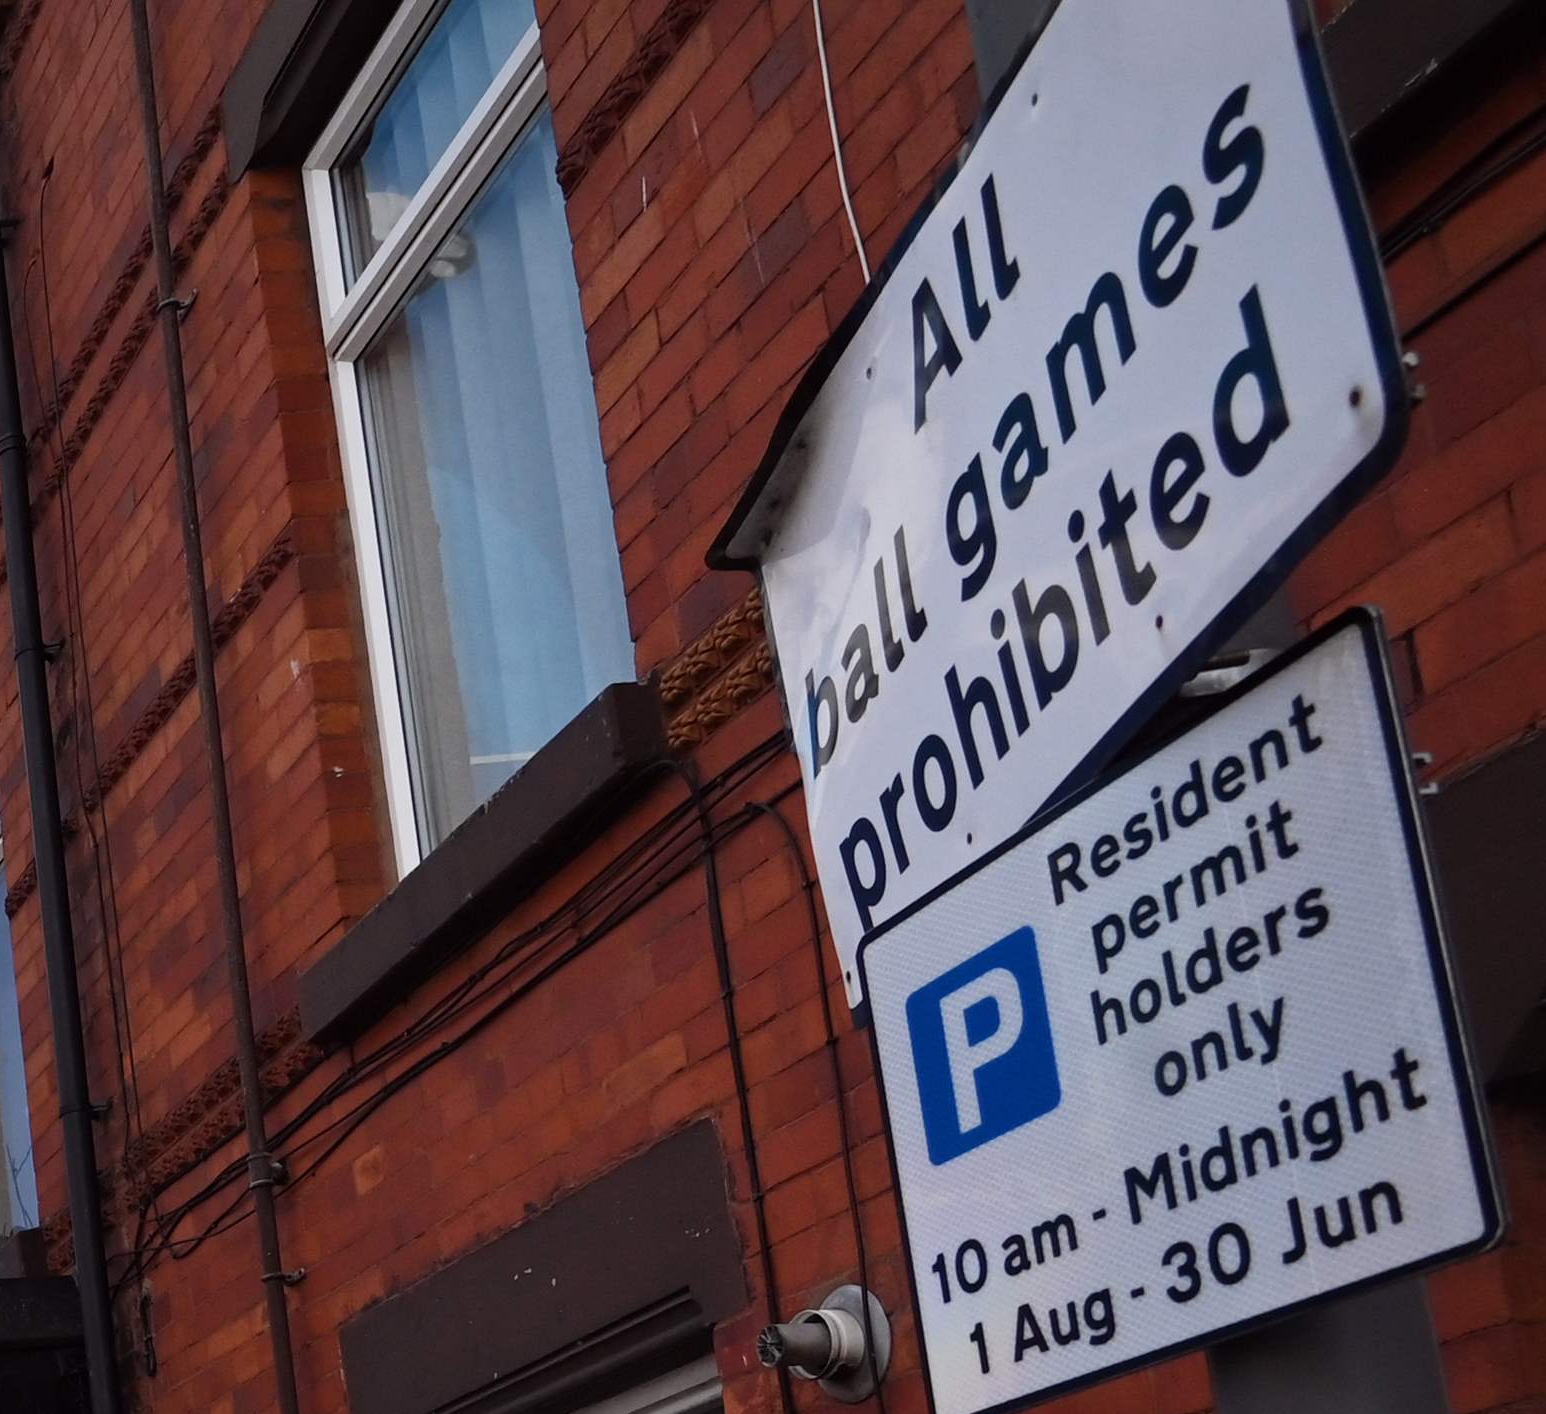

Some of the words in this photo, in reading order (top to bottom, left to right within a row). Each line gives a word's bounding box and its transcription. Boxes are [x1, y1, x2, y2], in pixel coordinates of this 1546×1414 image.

[909, 173, 1021, 434] All
[809, 526, 927, 777] ball
[945, 83, 1265, 603] games
[838, 284, 1291, 932] prohibited
[1047, 694, 1324, 906] Resident
[1091, 801, 1300, 973] permit
[939, 967, 1024, 1135] P
[1090, 887, 1331, 1045] holders
[1154, 996, 1285, 1097] only
[931, 1239, 988, 1303] 10
[1003, 1213, 1079, 1278] am
[1124, 1046, 1427, 1226] Midnight
[969, 1320, 991, 1375] 1
[1012, 1285, 1117, 1362] Aug
[1160, 1222, 1251, 1304] 30
[1281, 1180, 1404, 1264] Jun
